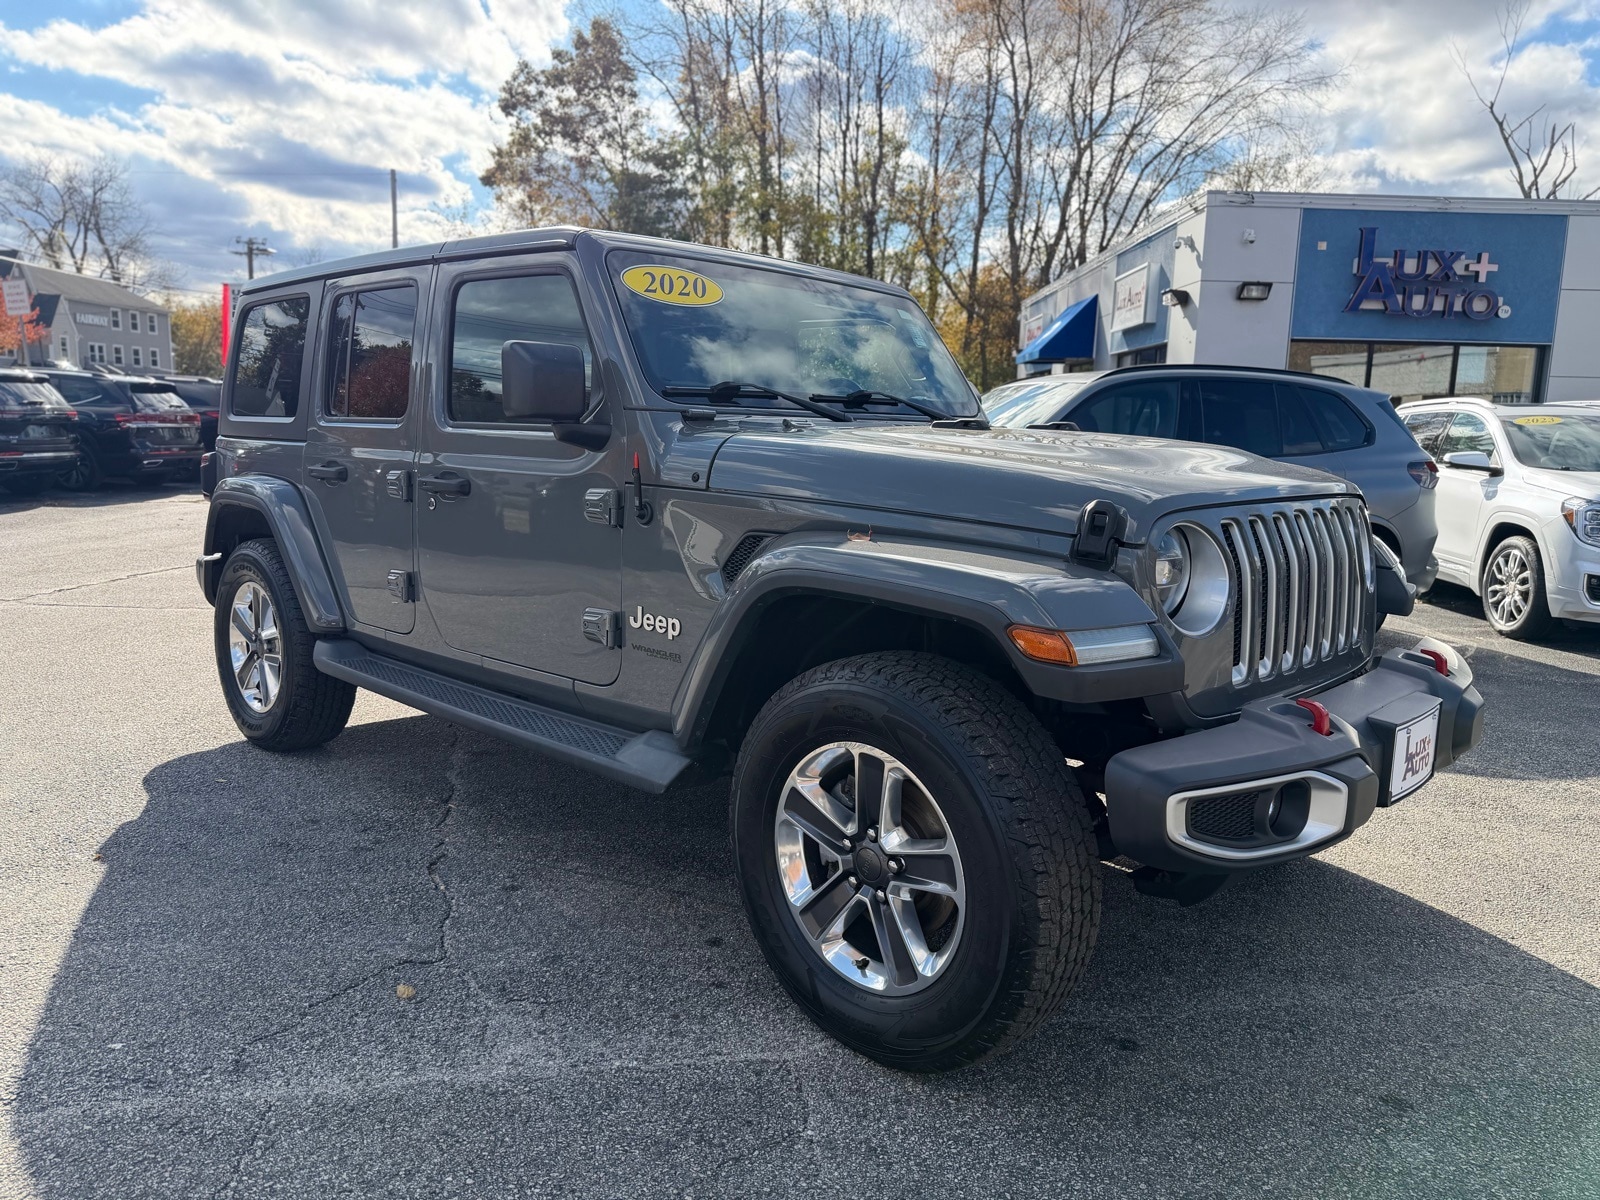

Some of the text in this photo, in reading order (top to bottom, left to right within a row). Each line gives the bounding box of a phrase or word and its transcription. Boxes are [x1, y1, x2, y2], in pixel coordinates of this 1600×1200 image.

[642, 271, 707, 298] 2020
[1342, 262, 1499, 320] AUTO
[76, 312, 109, 326] FAIRWAY
[629, 605, 681, 640] Jeep
[631, 643, 682, 659] WRANGLER
[1402, 751, 1430, 782] AUTO
